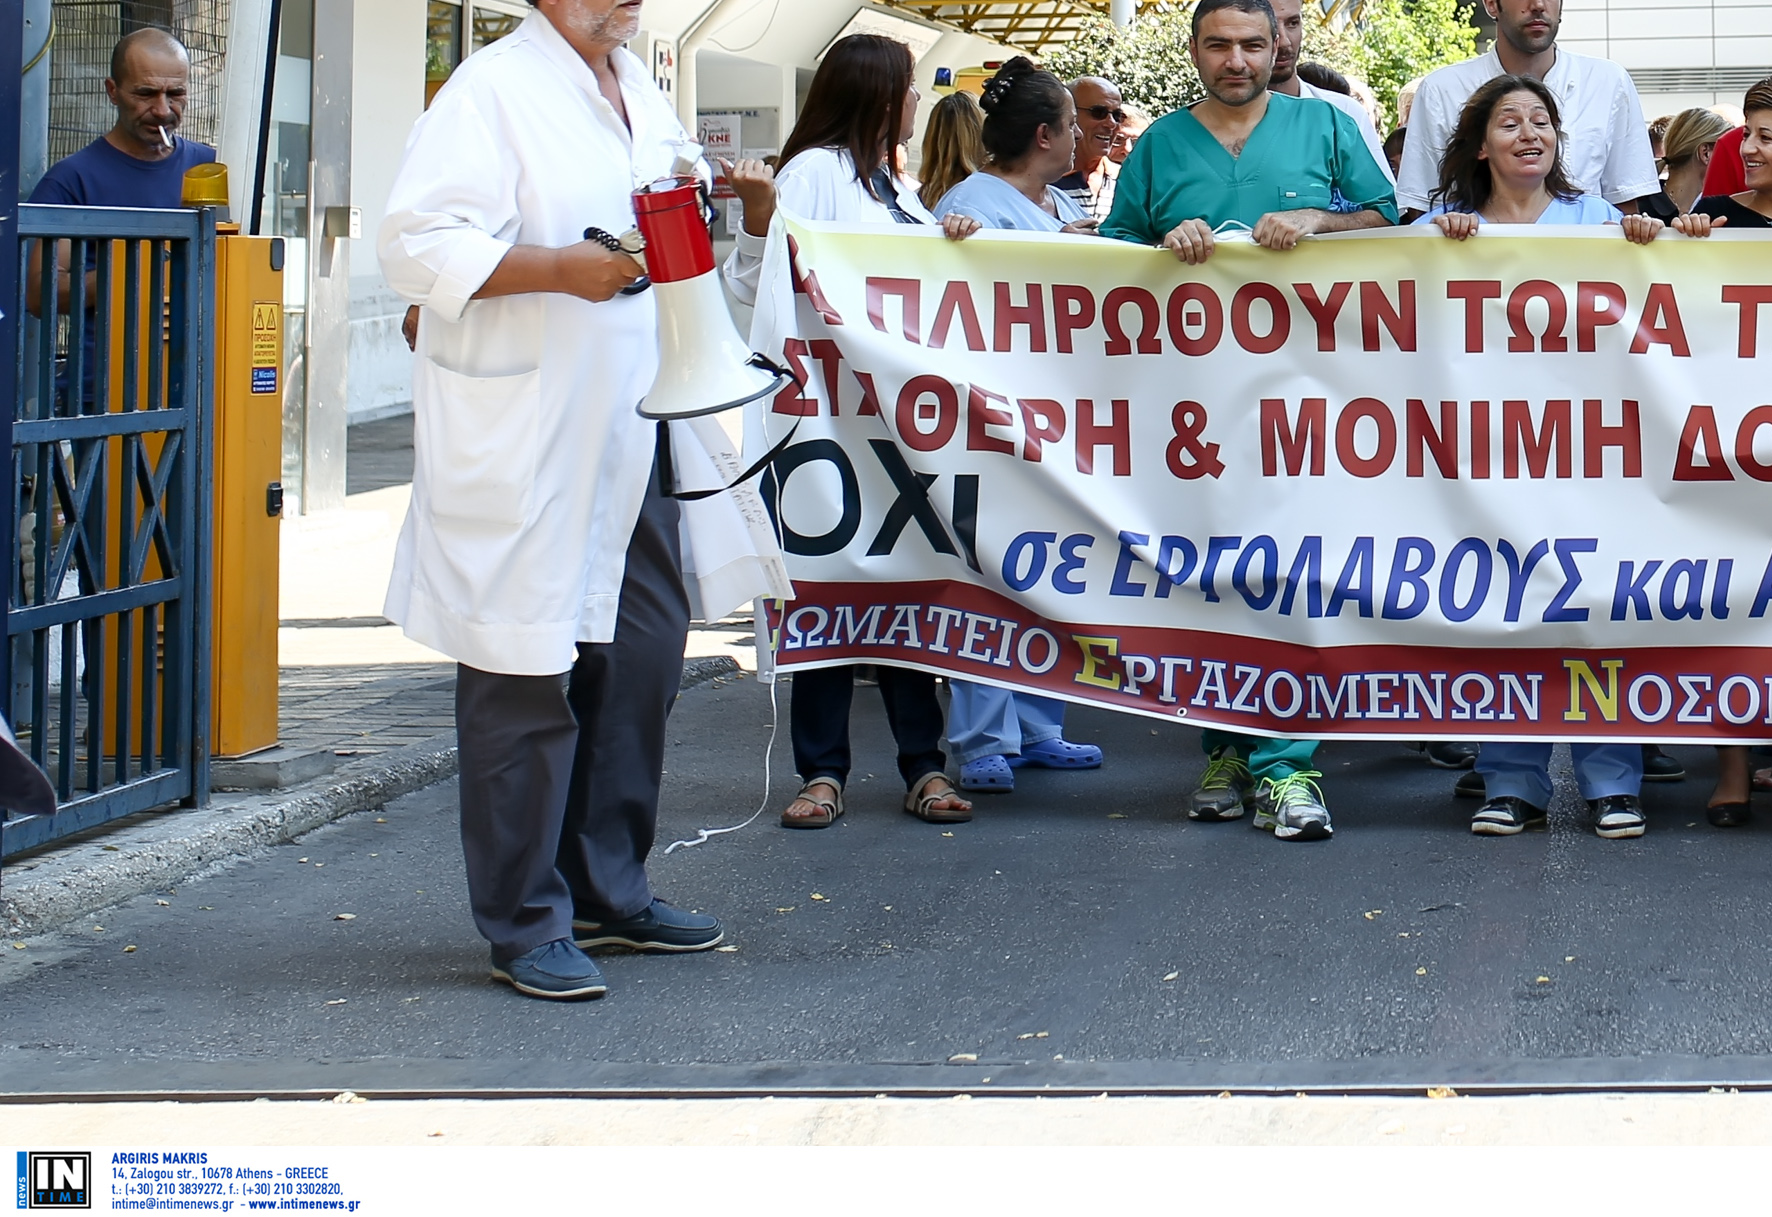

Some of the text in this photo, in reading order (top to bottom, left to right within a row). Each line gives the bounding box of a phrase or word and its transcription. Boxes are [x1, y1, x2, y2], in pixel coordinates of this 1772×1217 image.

[865, 276, 1418, 358] ΠΛΗΡΩΘΟΥΝ
[1446, 279, 1692, 358] ΤΩΡΑ
[1166, 400, 1226, 480] &
[1259, 396, 1643, 481] ΜΟΝΙΜΗ
[759, 438, 984, 576] ΟΧΙ
[1001, 530, 1096, 595] σε
[1108, 529, 1599, 624] ΕΡΓΟΛΑΒΟΥΣ
[1609, 557, 1732, 622] και
[1071, 633, 1543, 721] ΕΡΓΑΖΟΜΕΝΩΝ
